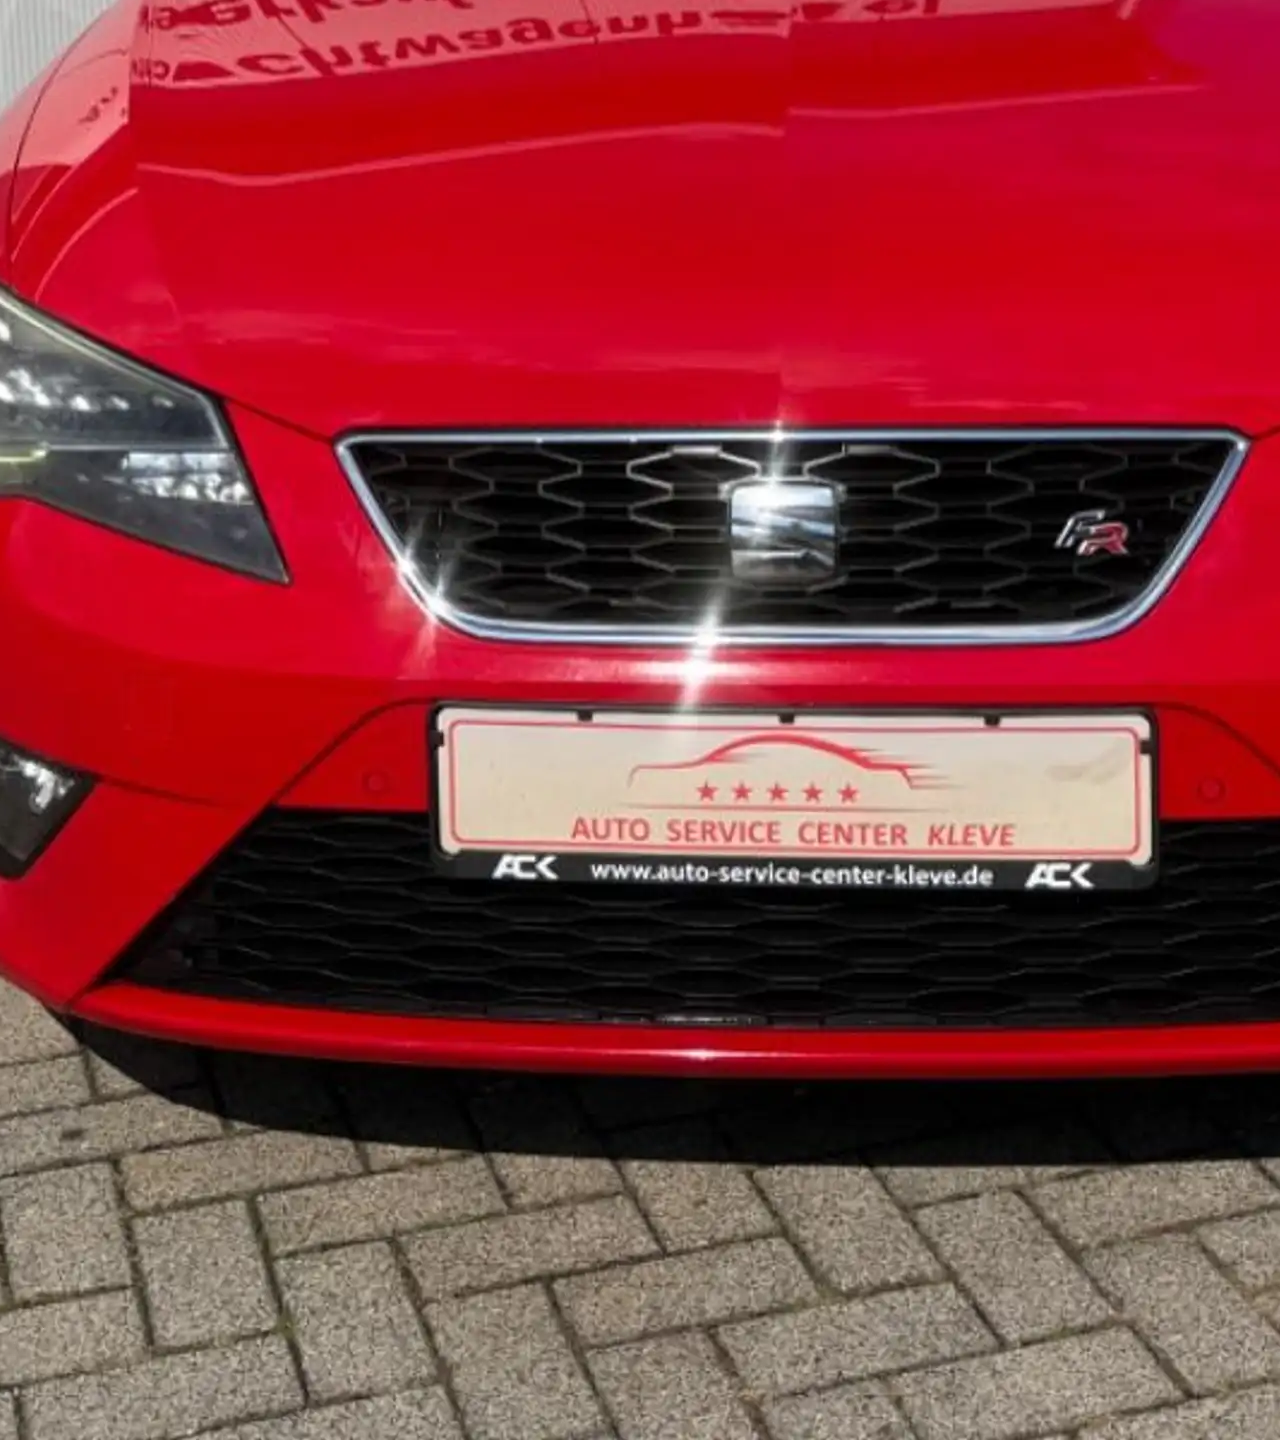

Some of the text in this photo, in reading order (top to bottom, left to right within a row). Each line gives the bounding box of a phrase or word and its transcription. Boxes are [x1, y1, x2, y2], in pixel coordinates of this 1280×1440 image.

[571, 817, 1017, 848] AUTO SERVICE CENTER KLEVE
[591, 861, 994, 887] www.auto-service-center-kleve.de
